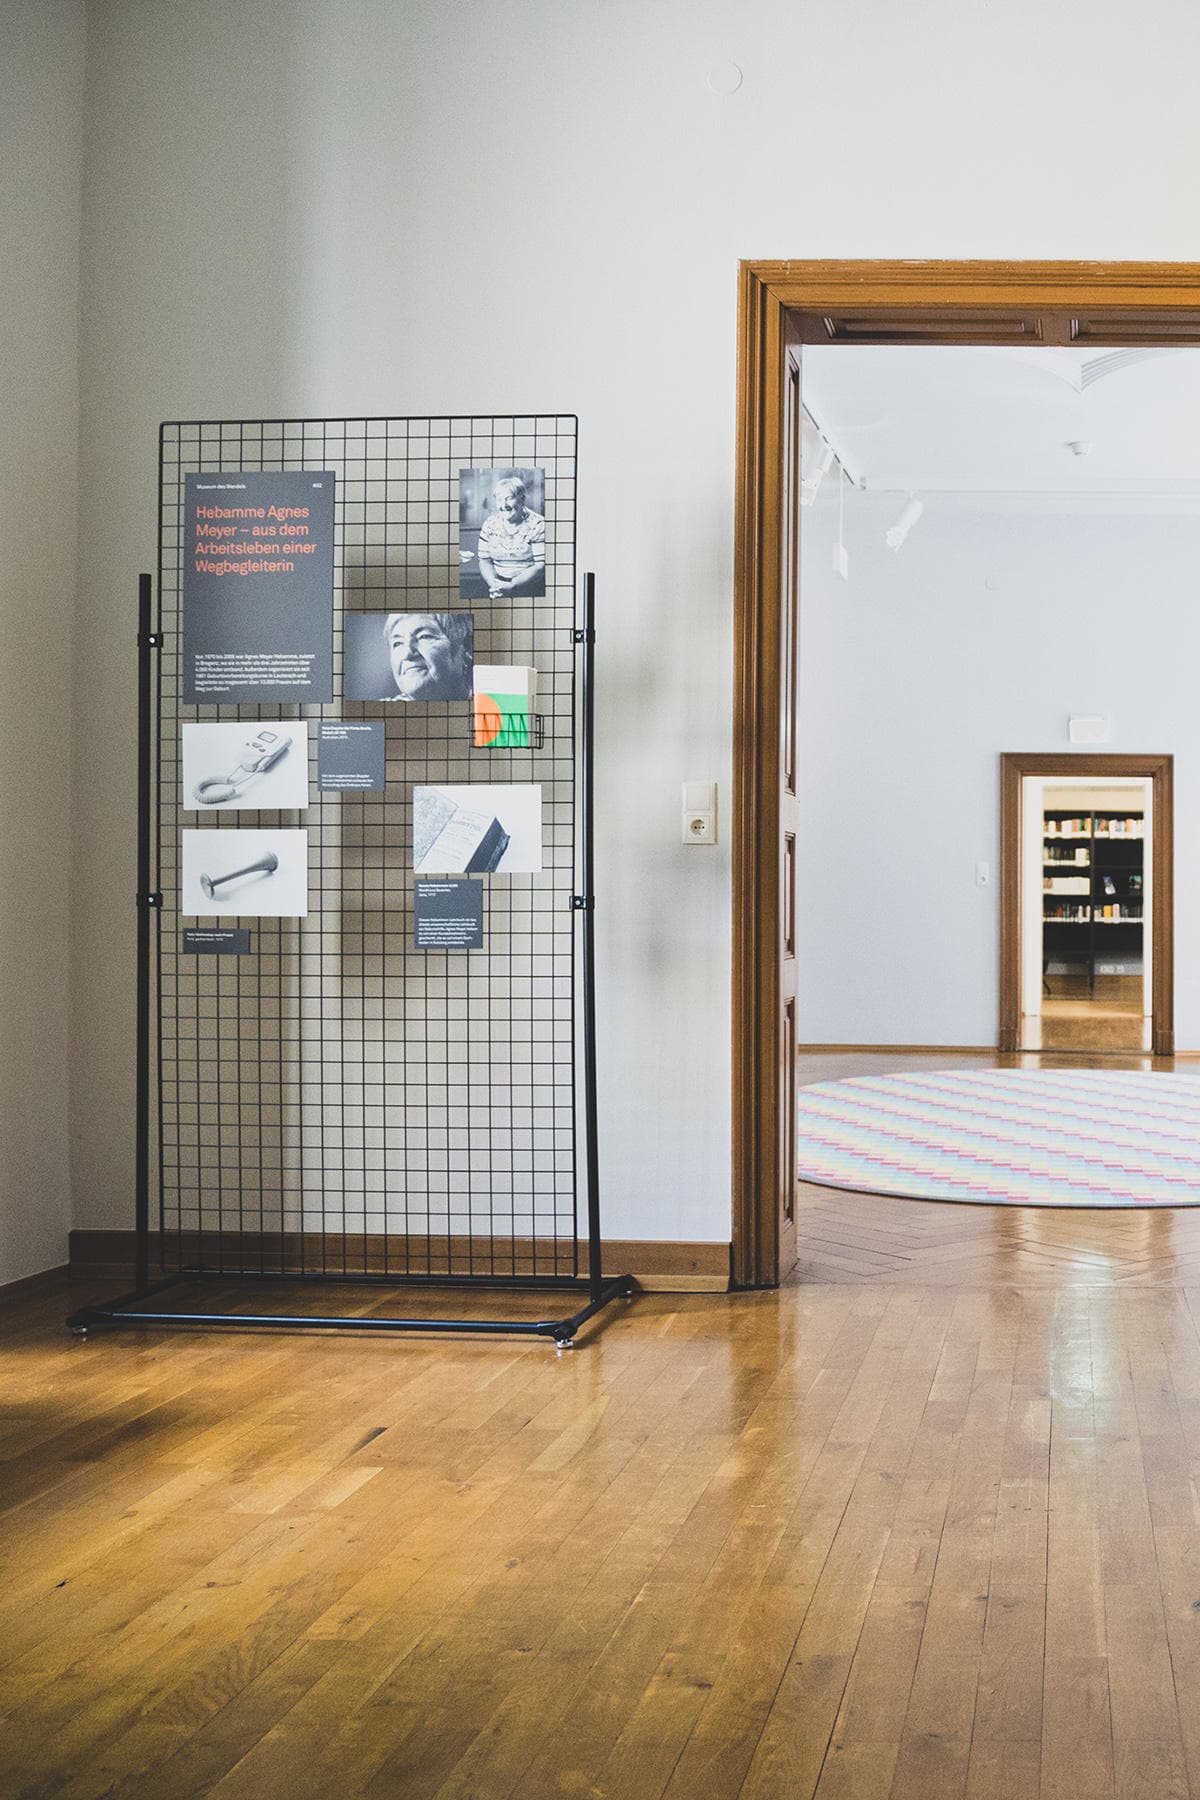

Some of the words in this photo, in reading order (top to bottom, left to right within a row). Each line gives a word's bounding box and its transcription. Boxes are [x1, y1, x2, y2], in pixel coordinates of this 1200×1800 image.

[196, 506, 266, 518] Hebamme
[267, 505, 310, 521] Agnes
[196, 524, 238, 540] Meyer
[252, 526, 276, 536] aus
[279, 523, 309, 536] dem
[195, 541, 280, 554] Arbeitsleben
[282, 540, 317, 554] einer
[195, 560, 294, 576] Wegbegleiterin
